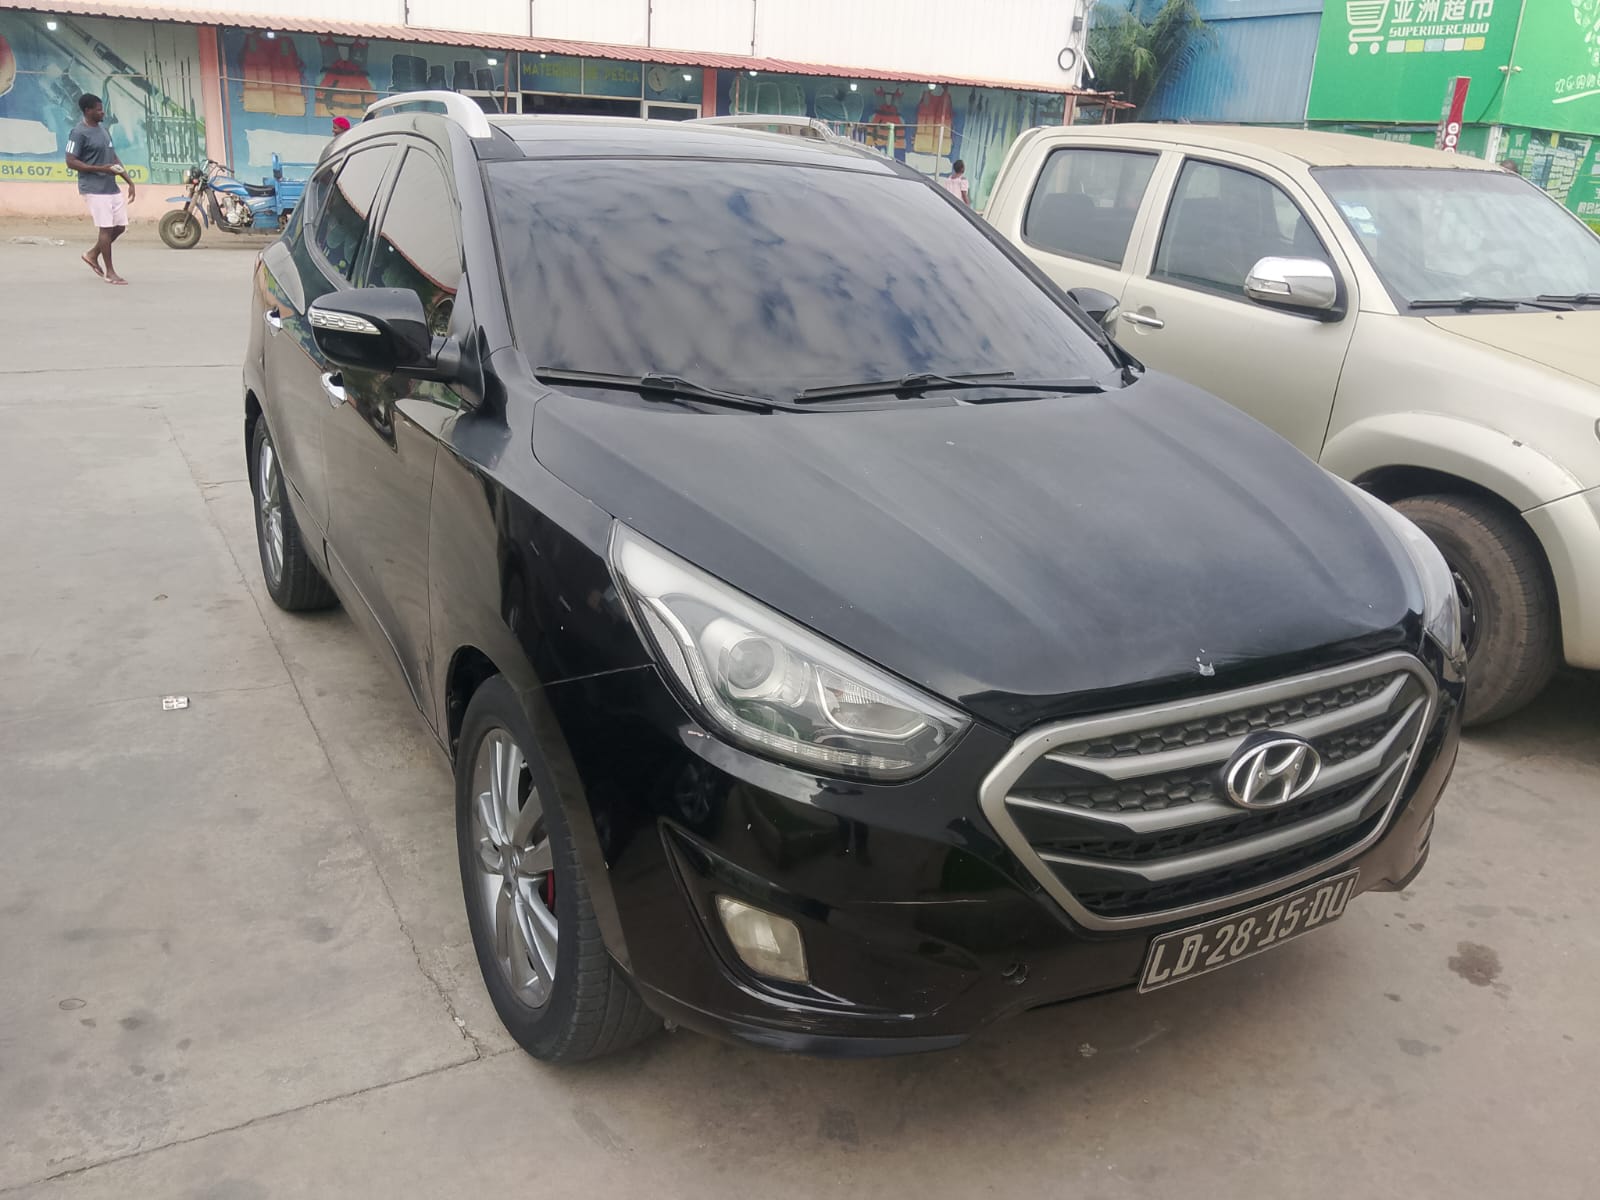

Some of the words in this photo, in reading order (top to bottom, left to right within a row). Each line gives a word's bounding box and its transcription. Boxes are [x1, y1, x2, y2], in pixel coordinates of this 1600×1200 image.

[1391, 0, 1494, 23] 亚洲超市
[1389, 23, 1490, 37] SUPERMERCADO
[604, 68, 639, 83] PESCA
[1, 165, 23, 176] 814
[27, 166, 52, 177] 607
